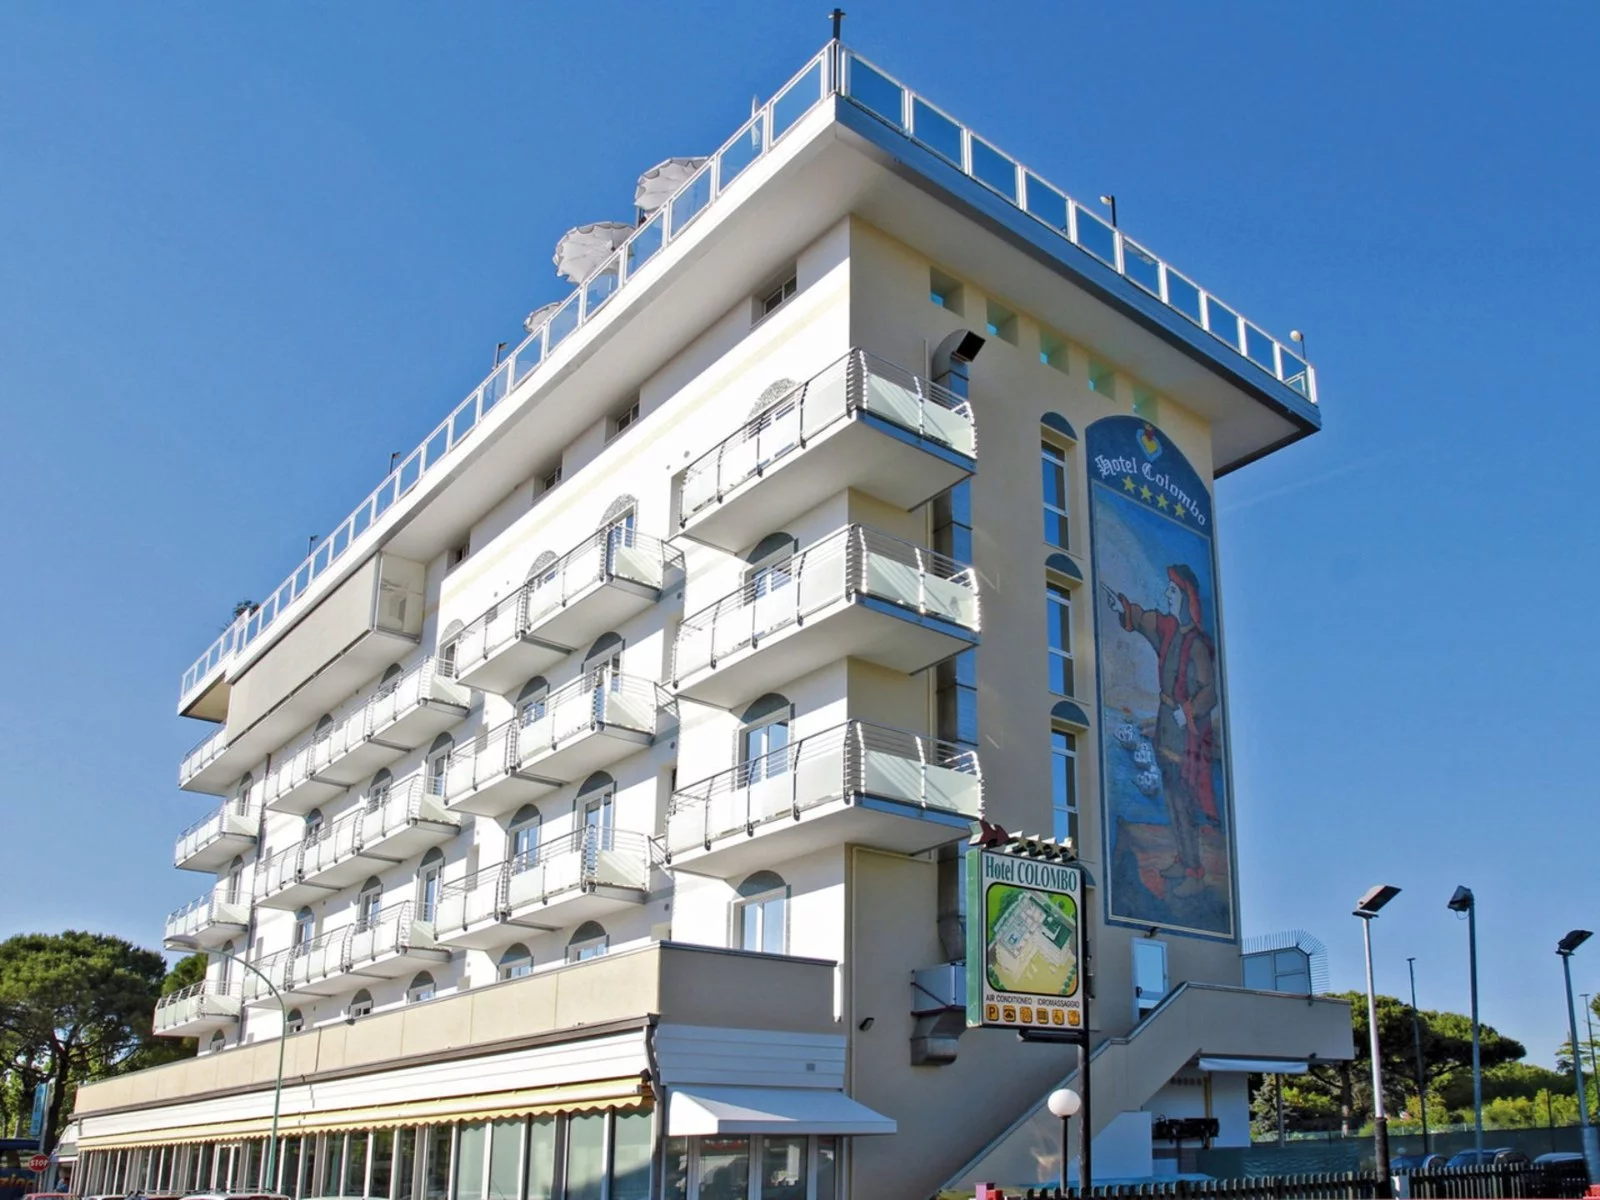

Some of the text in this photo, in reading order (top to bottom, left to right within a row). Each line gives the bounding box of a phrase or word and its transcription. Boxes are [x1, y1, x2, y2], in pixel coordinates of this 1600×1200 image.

[1095, 454, 1206, 526] Hotel Colombo
[985, 855, 1077, 892] Hotel COLOMBO
[986, 994, 995, 1002] AIR
[996, 995, 1032, 1004] CONDITIONED
[30, 1159, 48, 1167] STOP
